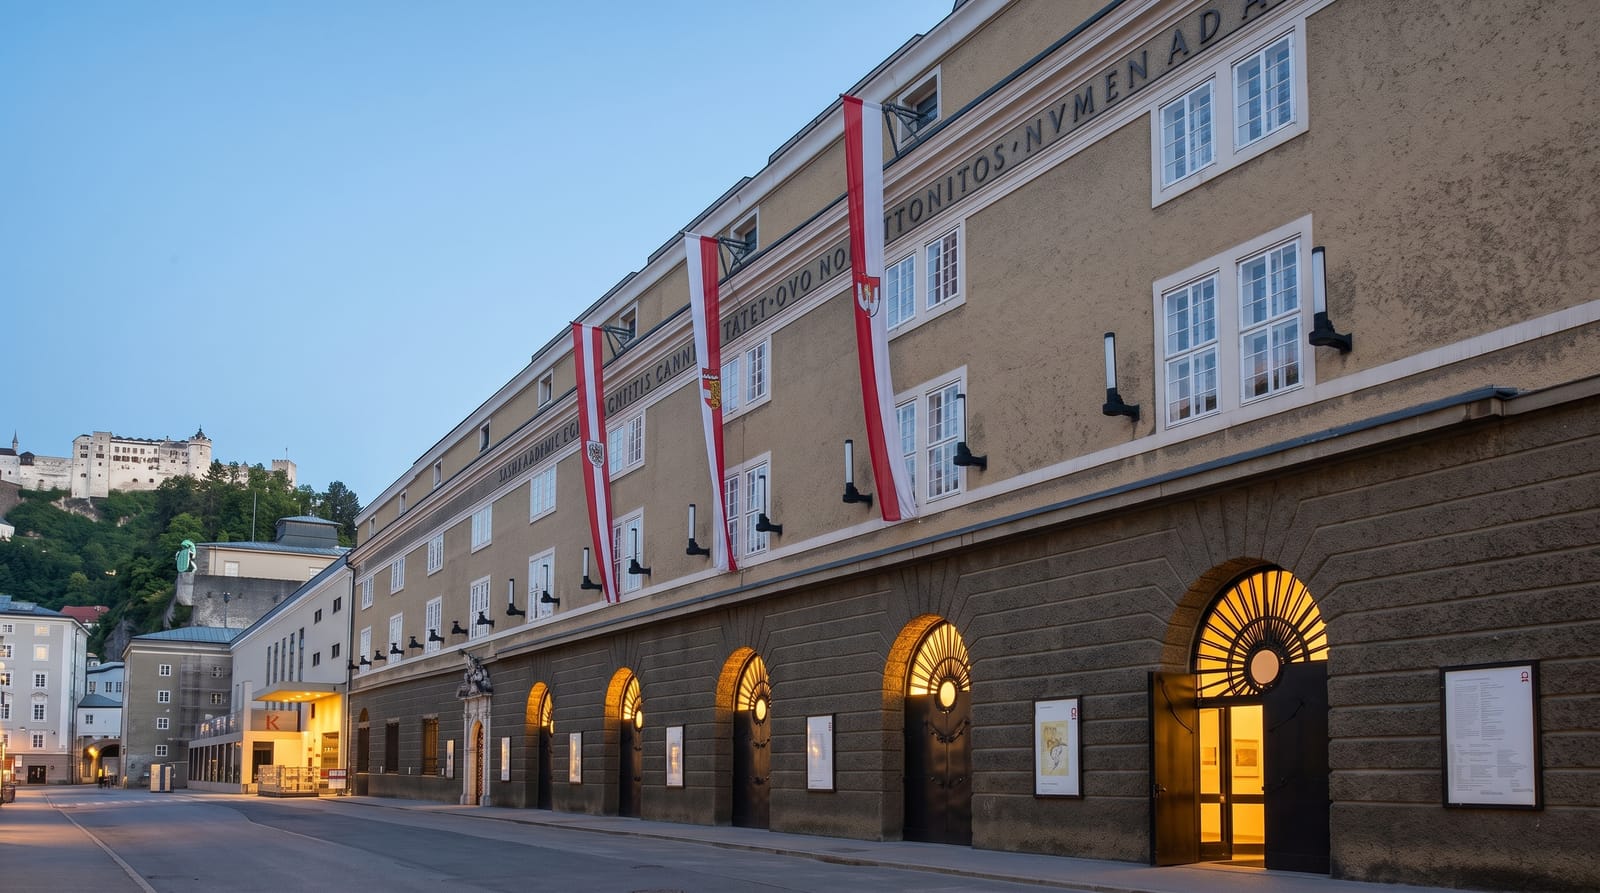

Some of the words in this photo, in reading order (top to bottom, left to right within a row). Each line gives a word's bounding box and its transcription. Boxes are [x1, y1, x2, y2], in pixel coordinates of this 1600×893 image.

[819, 248, 851, 280] NO
[1167, 9, 1220, 65] AD
[266, 714, 280, 730] K
